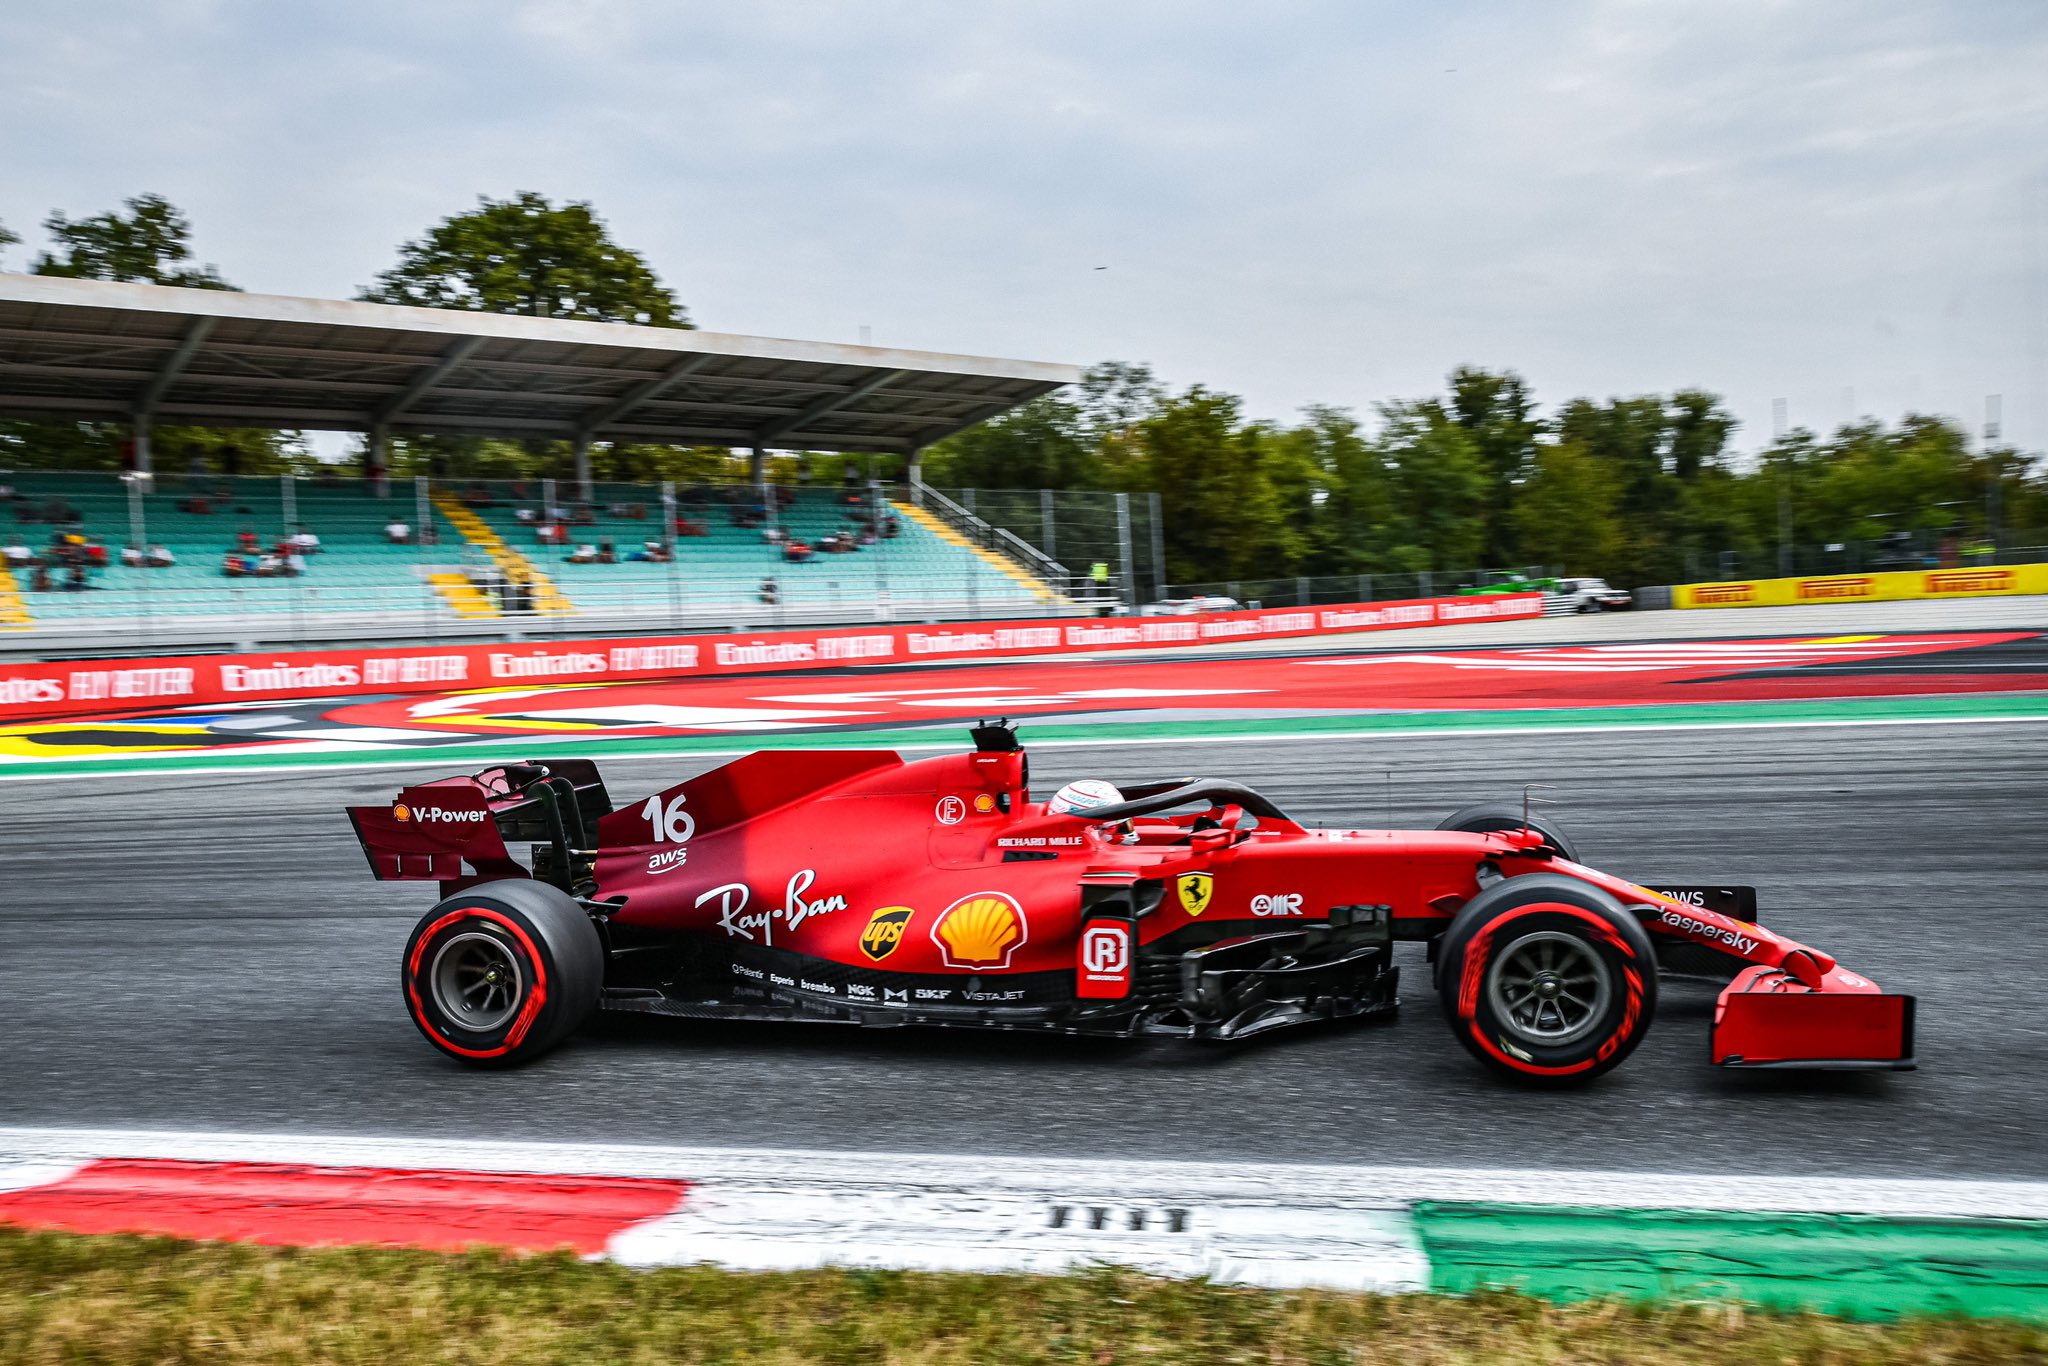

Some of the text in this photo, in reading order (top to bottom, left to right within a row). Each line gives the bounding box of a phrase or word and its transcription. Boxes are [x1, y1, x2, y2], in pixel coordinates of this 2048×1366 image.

[219, 662, 361, 691] Emirates
[488, 651, 608, 677] Emirates
[412, 807, 487, 823] V-Power
[642, 794, 695, 843] 16
[998, 836, 1082, 847] RICHARD MILLE
[649, 847, 688, 869] aws
[864, 921, 904, 951] ups
[770, 973, 795, 986] Experis
[801, 979, 836, 993] brembo
[847, 984, 875, 996] NGK
[915, 989, 952, 999] SKF
